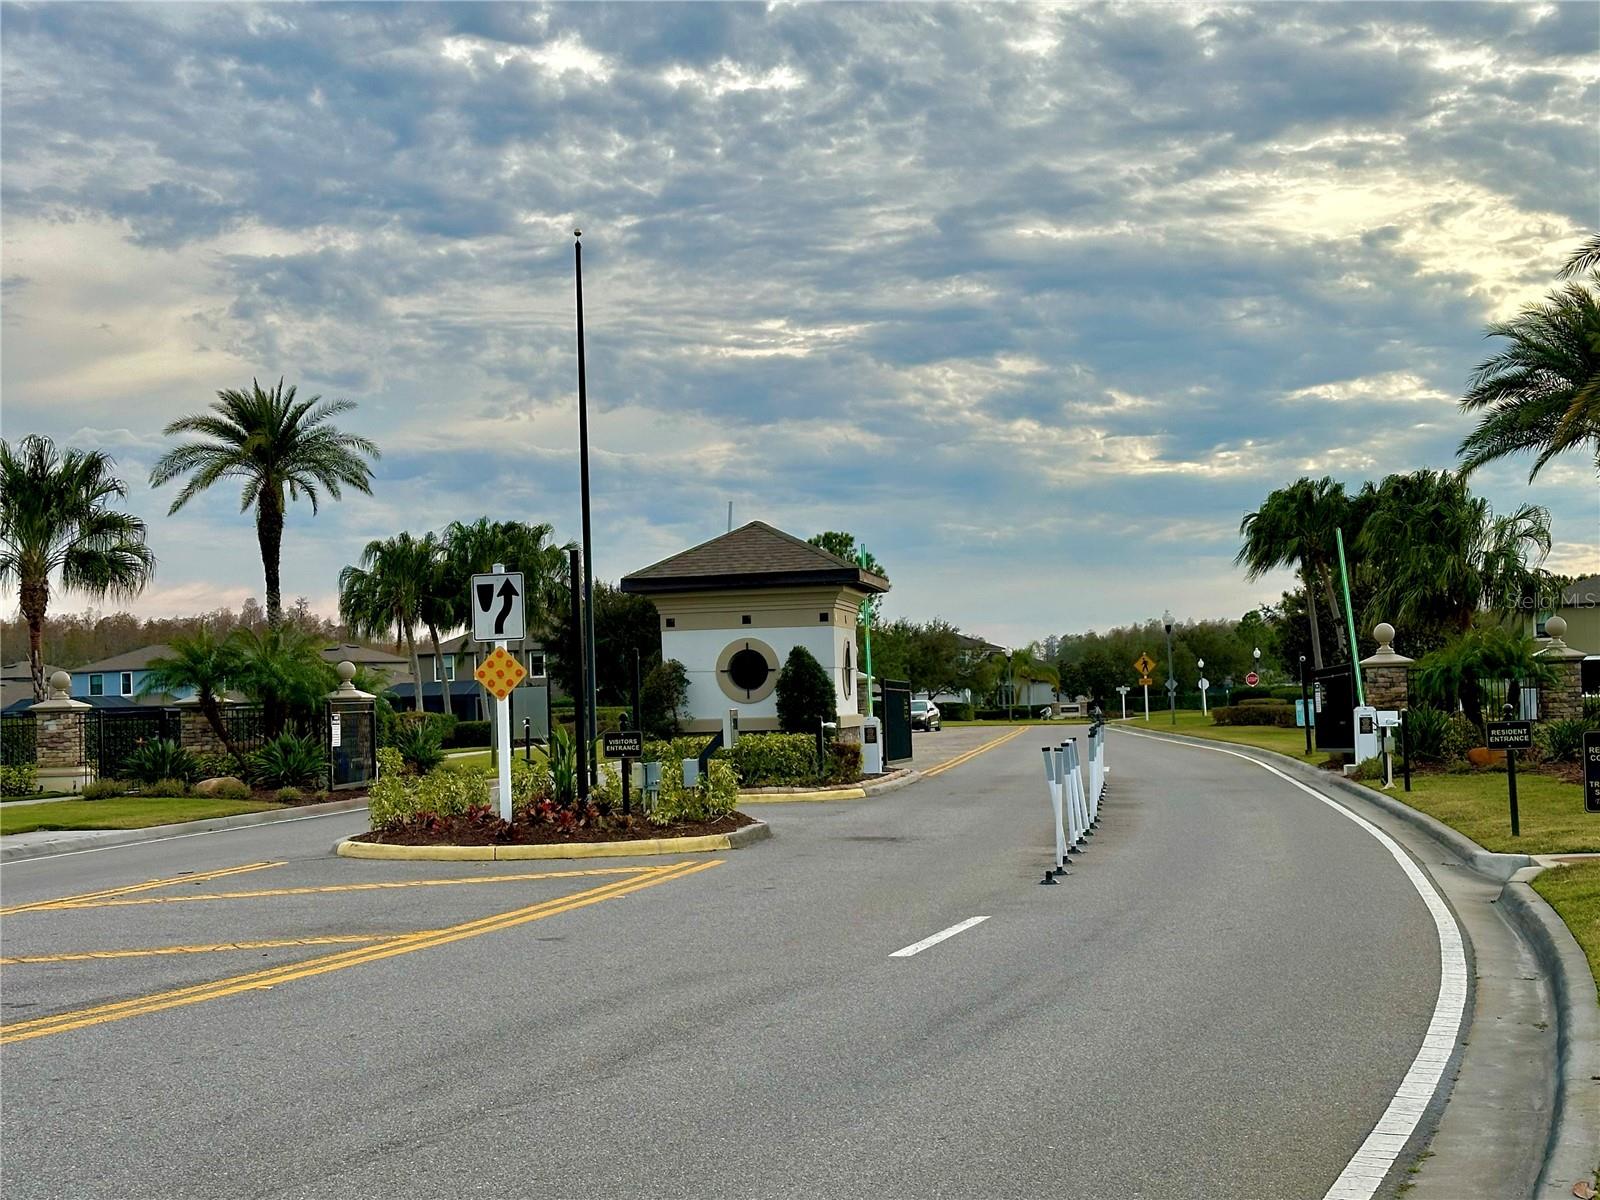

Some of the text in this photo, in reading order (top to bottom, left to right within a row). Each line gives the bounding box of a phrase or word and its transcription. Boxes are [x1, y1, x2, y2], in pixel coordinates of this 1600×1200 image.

[1491, 728, 1528, 736] RESIDENT
[1490, 735, 1530, 743] ENTRANCE
[606, 744, 640, 752] ENTRANCE
[1588, 746, 1600, 754] RE
[1590, 754, 1600, 762] CO
[1589, 780, 1600, 788] TR
